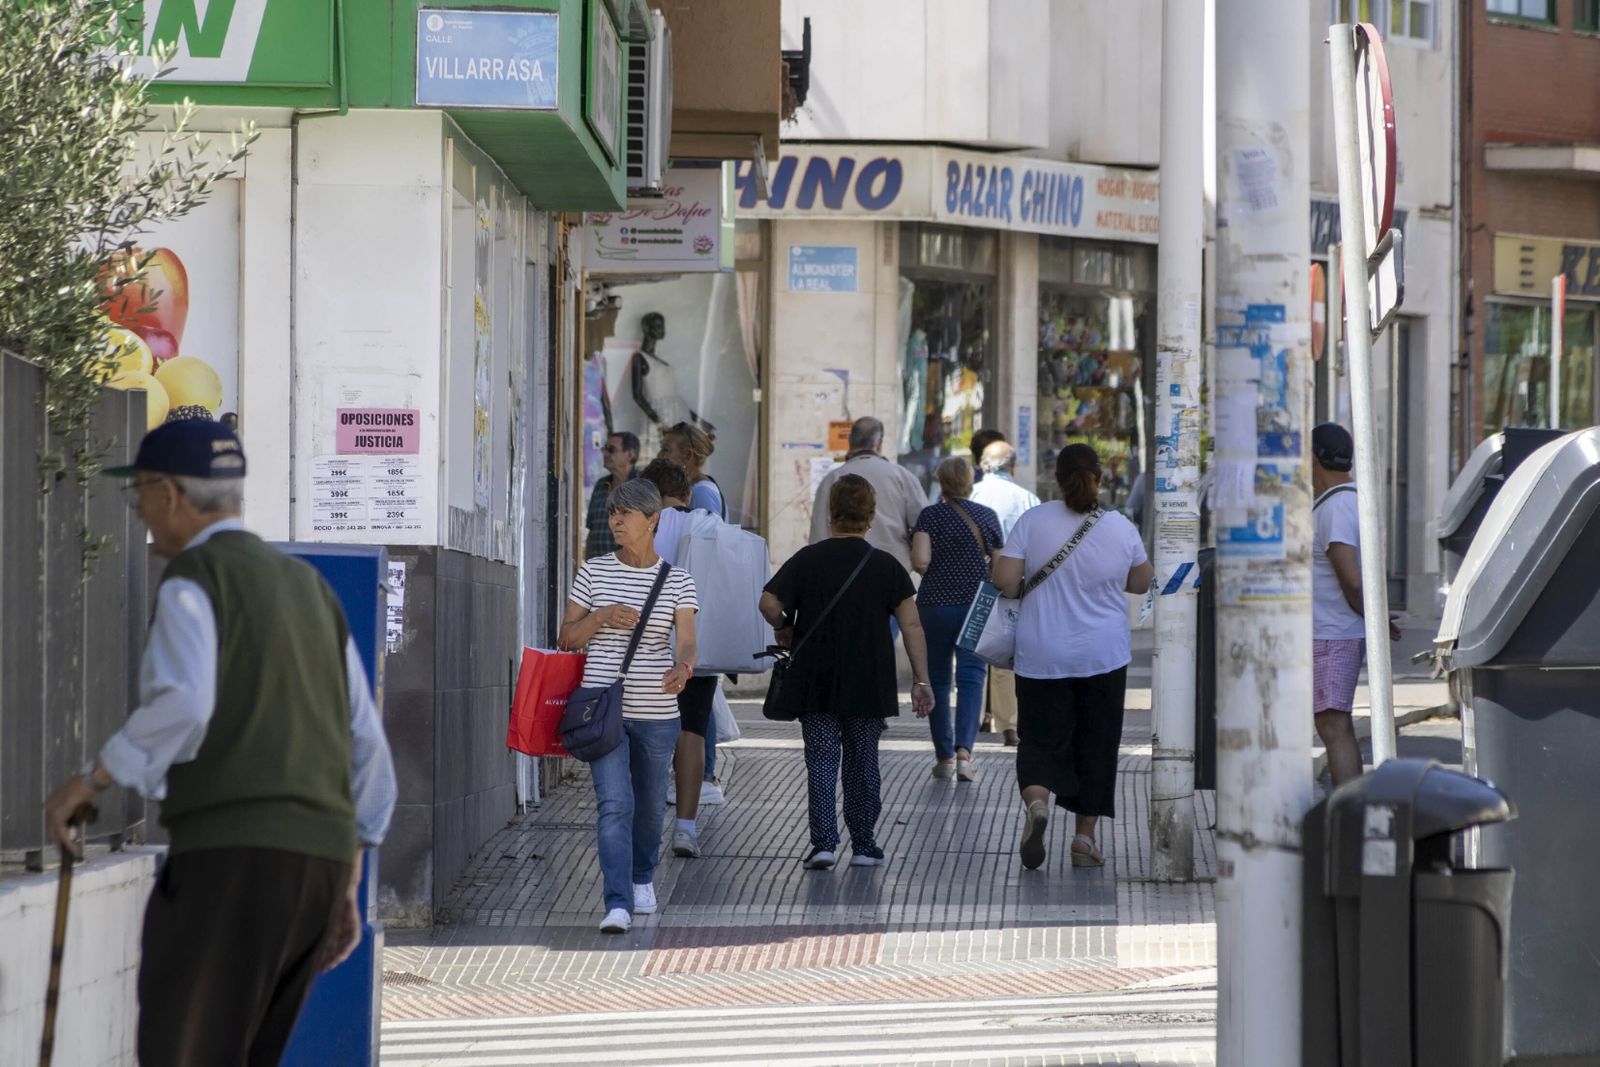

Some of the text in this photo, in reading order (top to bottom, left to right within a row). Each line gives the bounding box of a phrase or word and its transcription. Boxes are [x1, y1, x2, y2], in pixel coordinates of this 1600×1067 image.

[426, 35, 453, 43] CALLE
[425, 57, 543, 81] VILLARRASA
[946, 160, 1083, 228] BAZAR CHINO
[652, 201, 711, 225] Dafne
[792, 264, 854, 276] ALMONASTER
[341, 413, 414, 426] OPOSICIONES
[354, 435, 404, 448] JUSTICIA
[1070, 520, 1093, 545] BIMBA
[1047, 549, 1069, 570] LOLA
